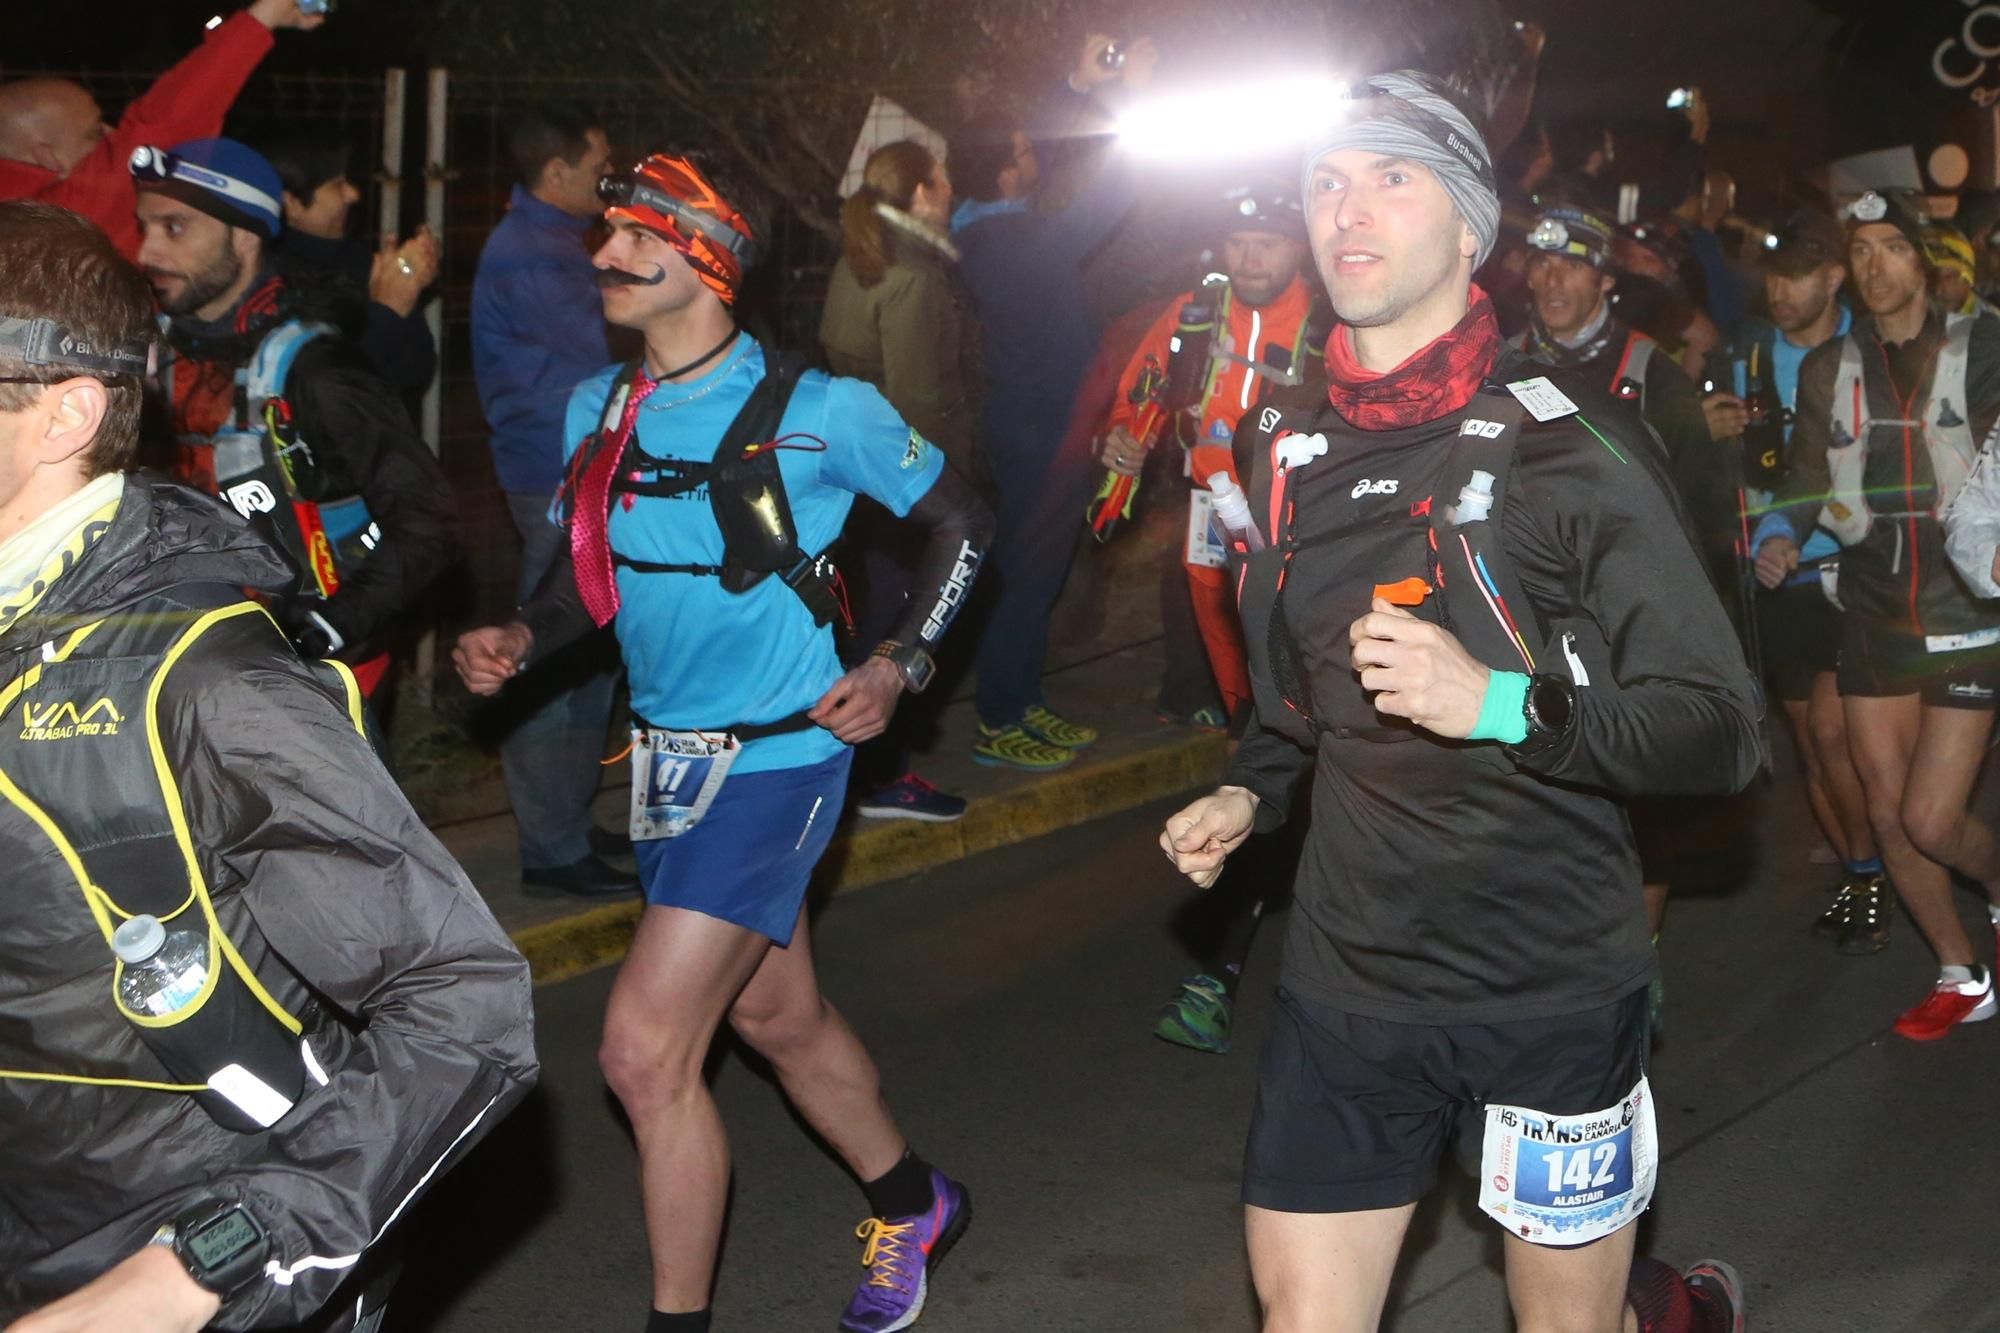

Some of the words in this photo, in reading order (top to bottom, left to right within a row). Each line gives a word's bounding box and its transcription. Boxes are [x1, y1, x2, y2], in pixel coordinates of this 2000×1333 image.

[1446, 133, 1482, 172] Bushnell
[921, 539, 978, 641] SPORT
[75, 722, 101, 737] PRO
[102, 722, 119, 736] 3L
[1584, 1122, 1622, 1142] CANARIA
[1585, 1118, 1611, 1132] GRAN
[1542, 1141, 1617, 1192] 142
[1552, 1189, 1604, 1206] ALASTAIR
